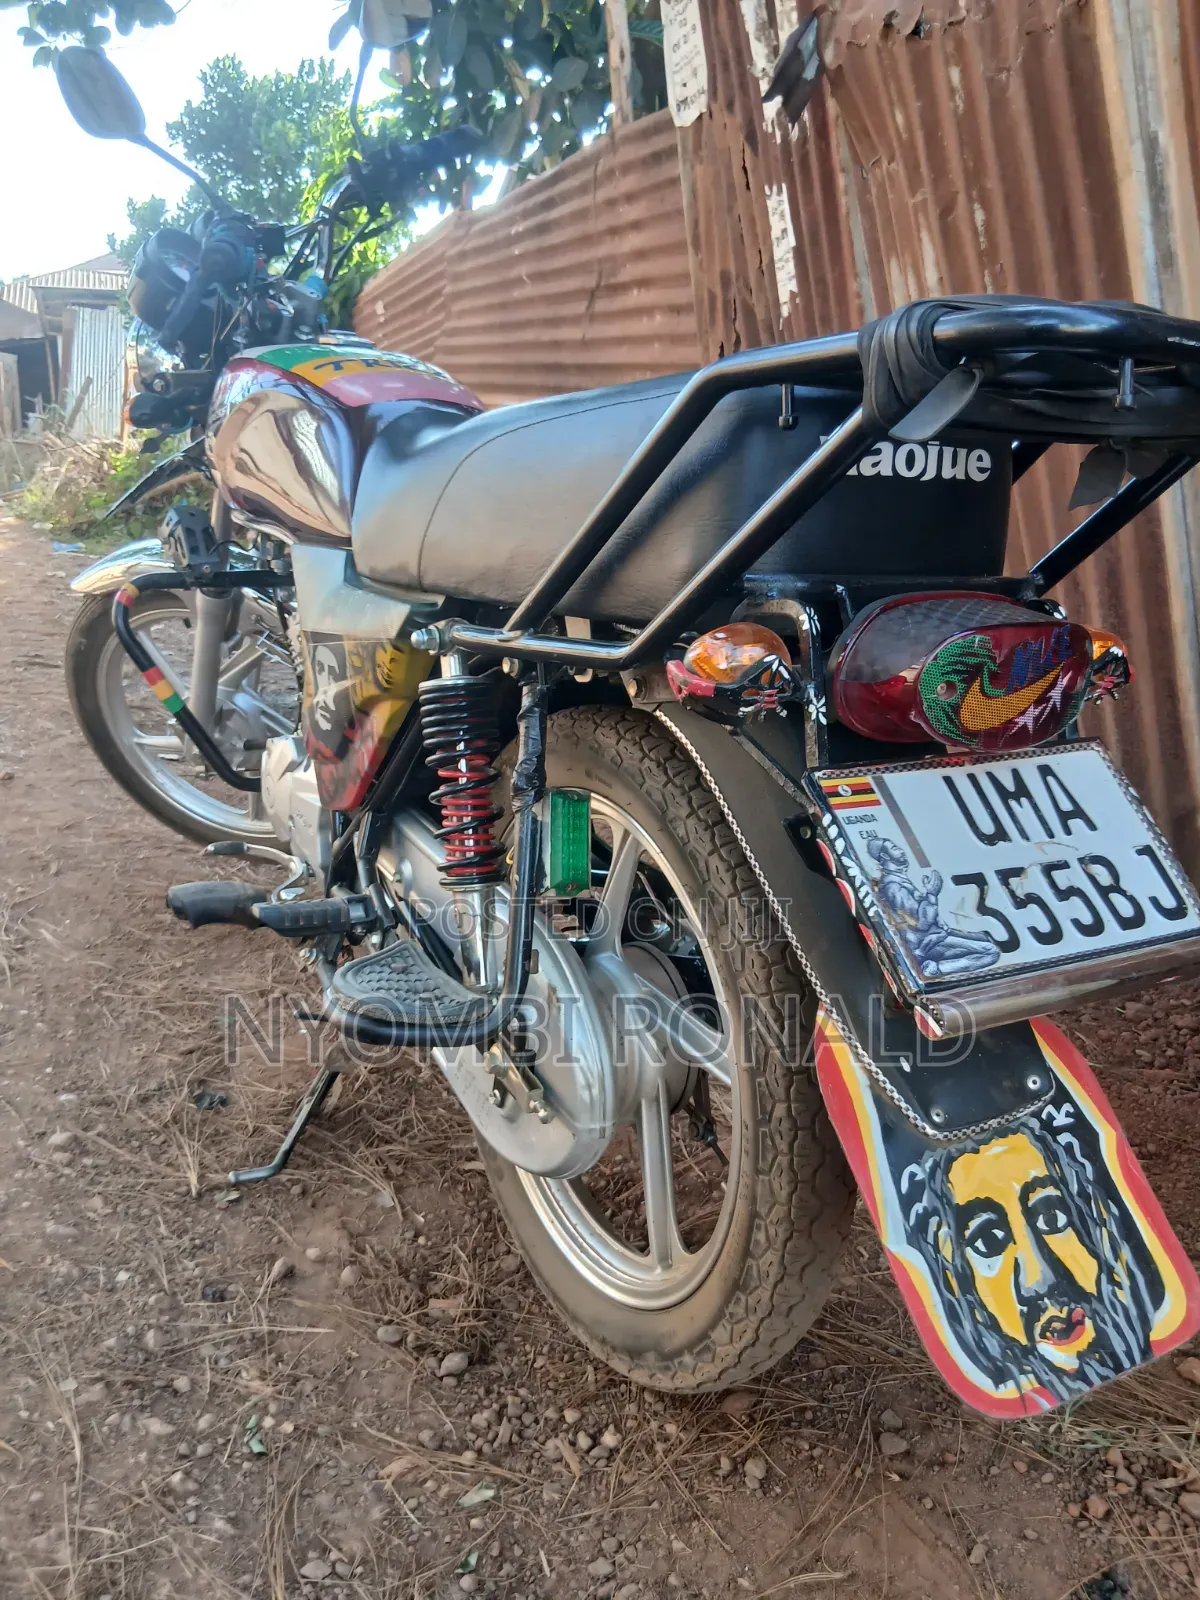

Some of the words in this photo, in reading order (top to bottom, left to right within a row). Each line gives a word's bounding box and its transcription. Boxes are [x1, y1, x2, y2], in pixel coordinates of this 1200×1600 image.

[819, 435, 992, 482] aojue
[842, 813, 878, 825] UGANDA
[942, 764, 1098, 846] UMA
